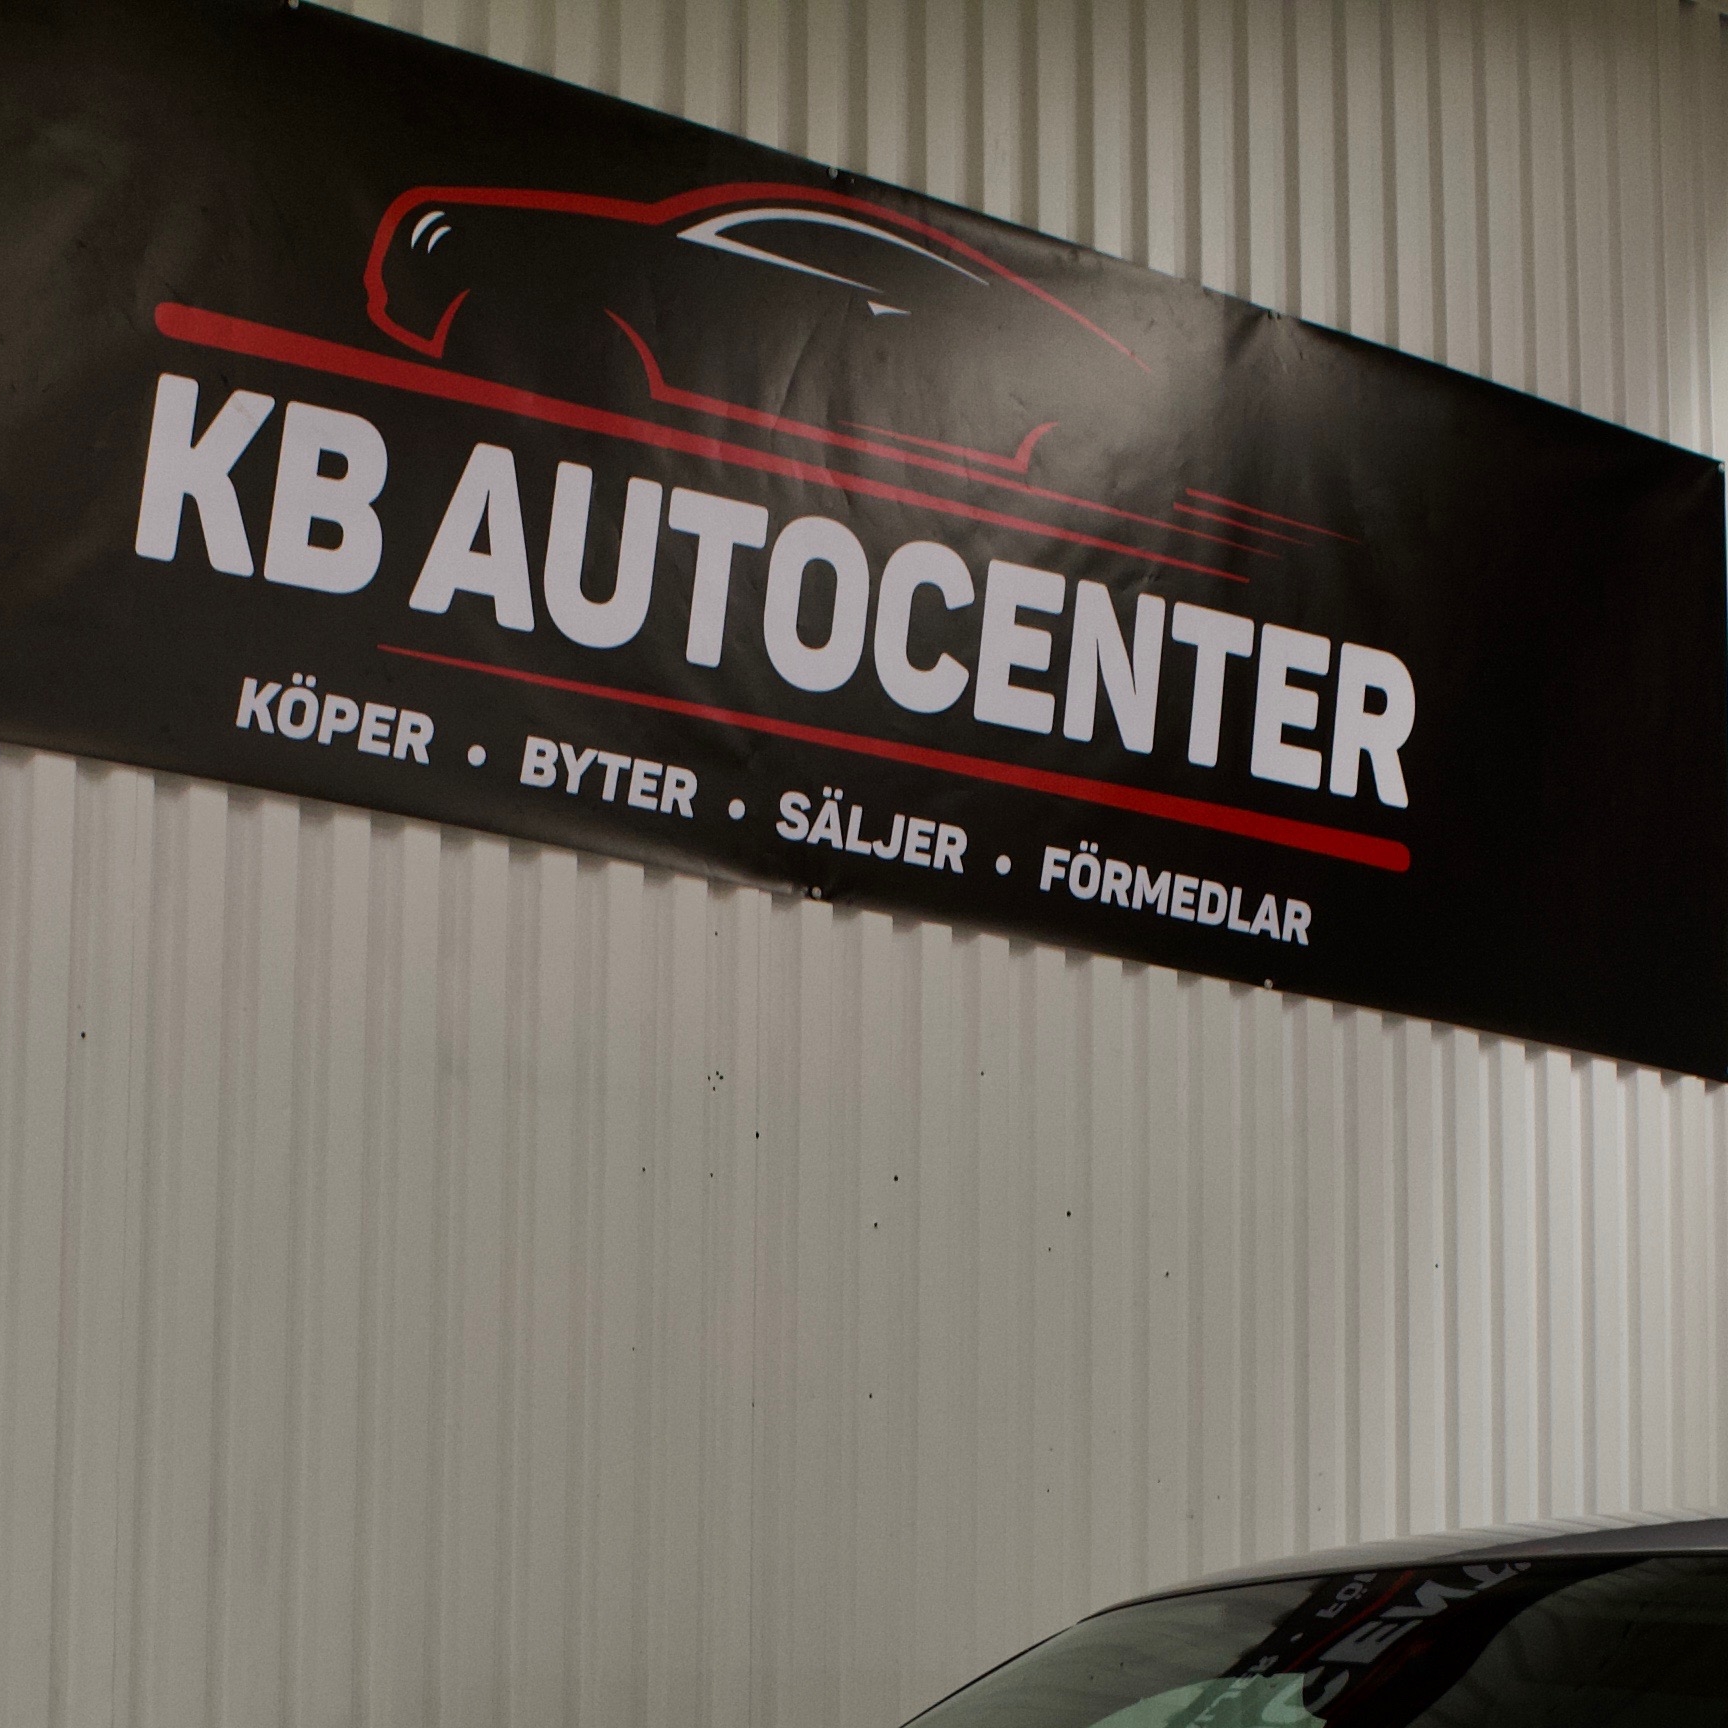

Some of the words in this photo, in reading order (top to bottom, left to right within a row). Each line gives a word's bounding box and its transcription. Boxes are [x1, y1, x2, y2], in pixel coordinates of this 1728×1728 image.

[133, 372, 389, 595] KB
[407, 441, 1417, 810] AUTOCENTER
[234, 671, 436, 766] KÖPER
[518, 734, 699, 819] BYTER
[774, 785, 969, 875] SÄLJER
[1038, 839, 1313, 947] FÖRMEDLAR
